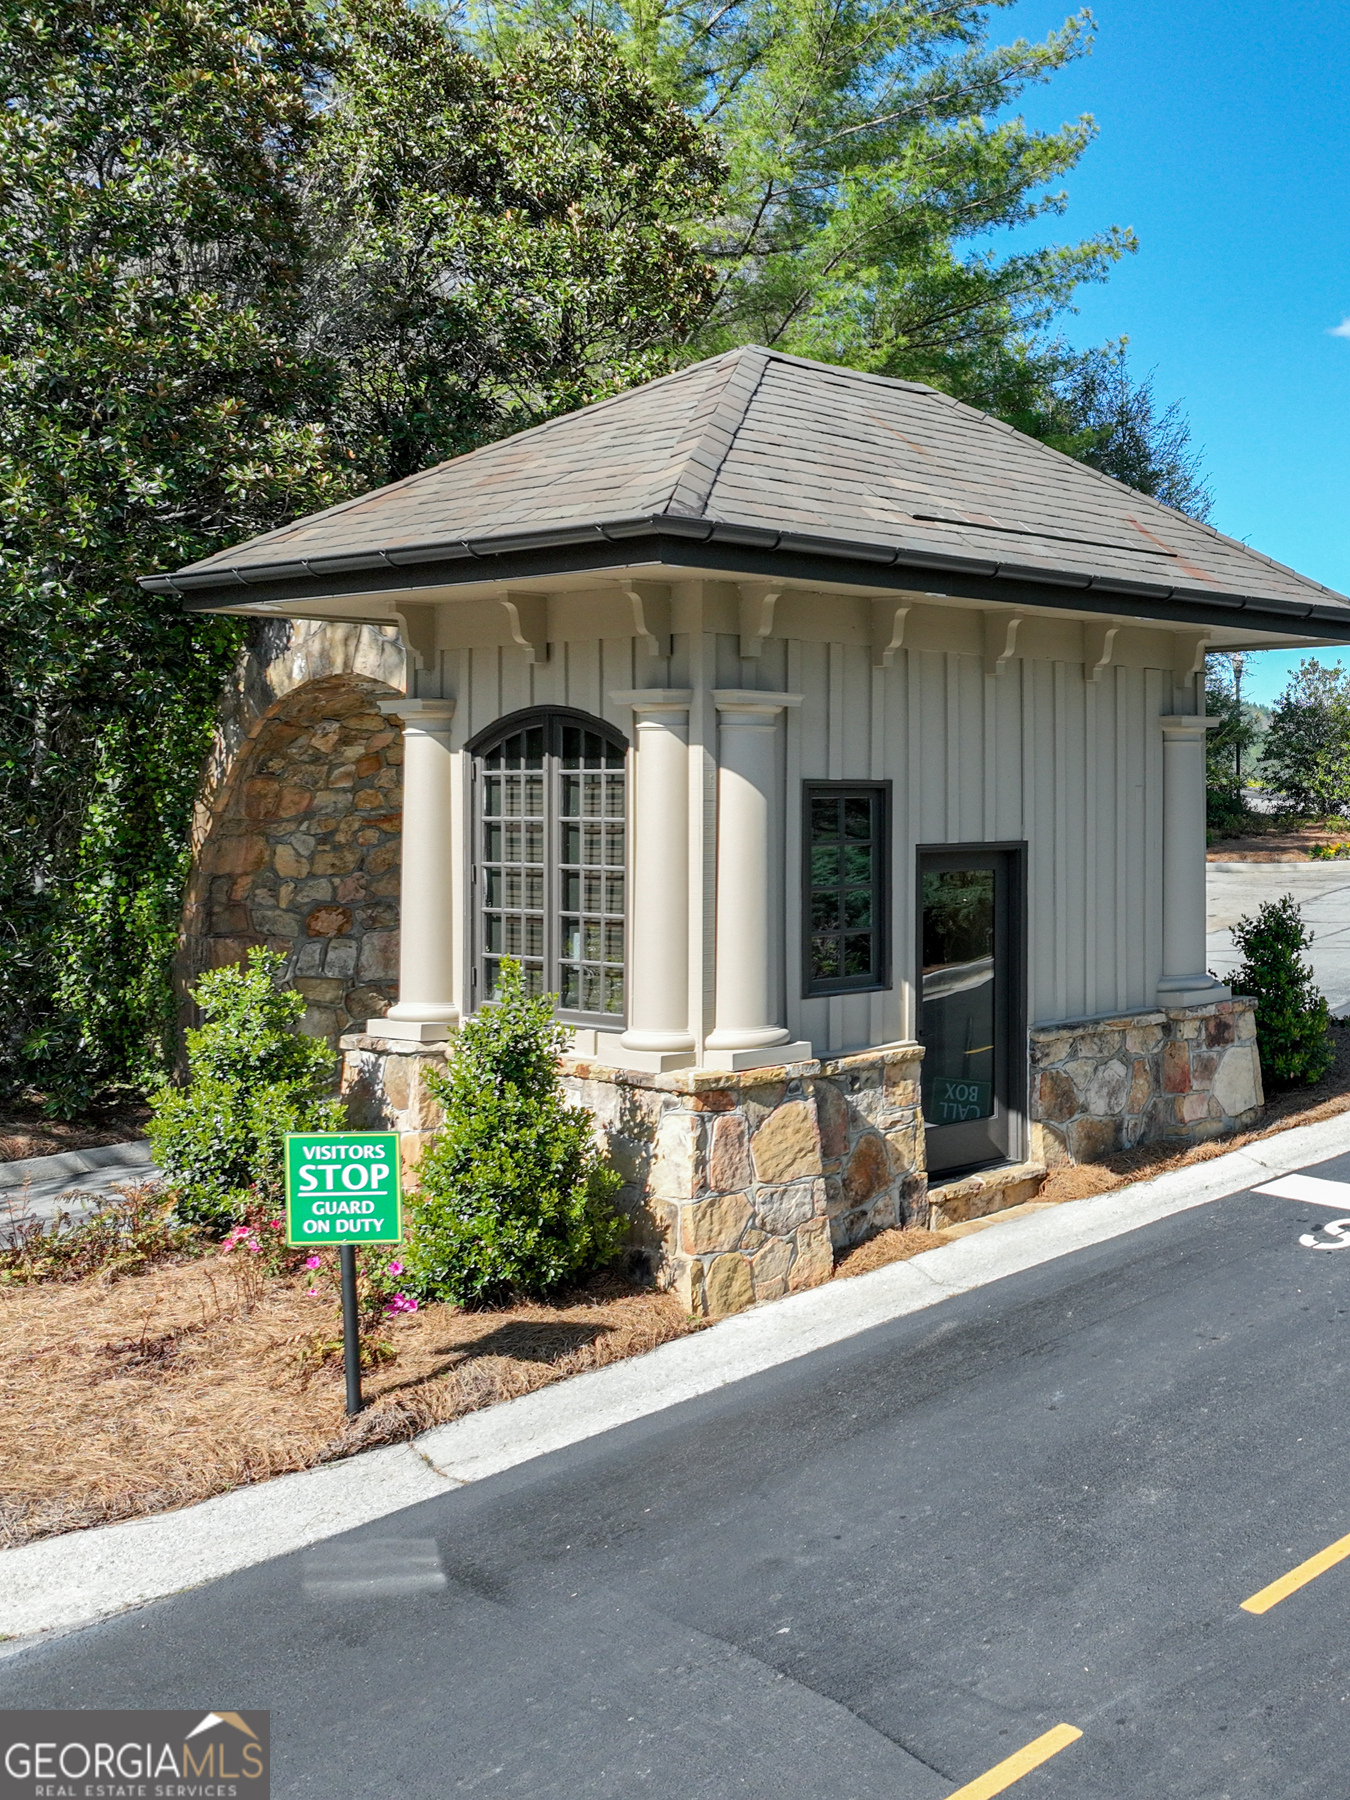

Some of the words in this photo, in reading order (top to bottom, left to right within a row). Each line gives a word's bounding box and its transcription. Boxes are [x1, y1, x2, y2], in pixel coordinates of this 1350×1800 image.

[944, 1083, 978, 1102] BOX
[940, 1102, 980, 1120] CALL
[302, 1144, 386, 1160] VISITORS
[298, 1163, 390, 1191] STOP
[311, 1200, 375, 1215] GUARD
[302, 1219, 330, 1234] ON
[335, 1218, 385, 1233] DUTY
